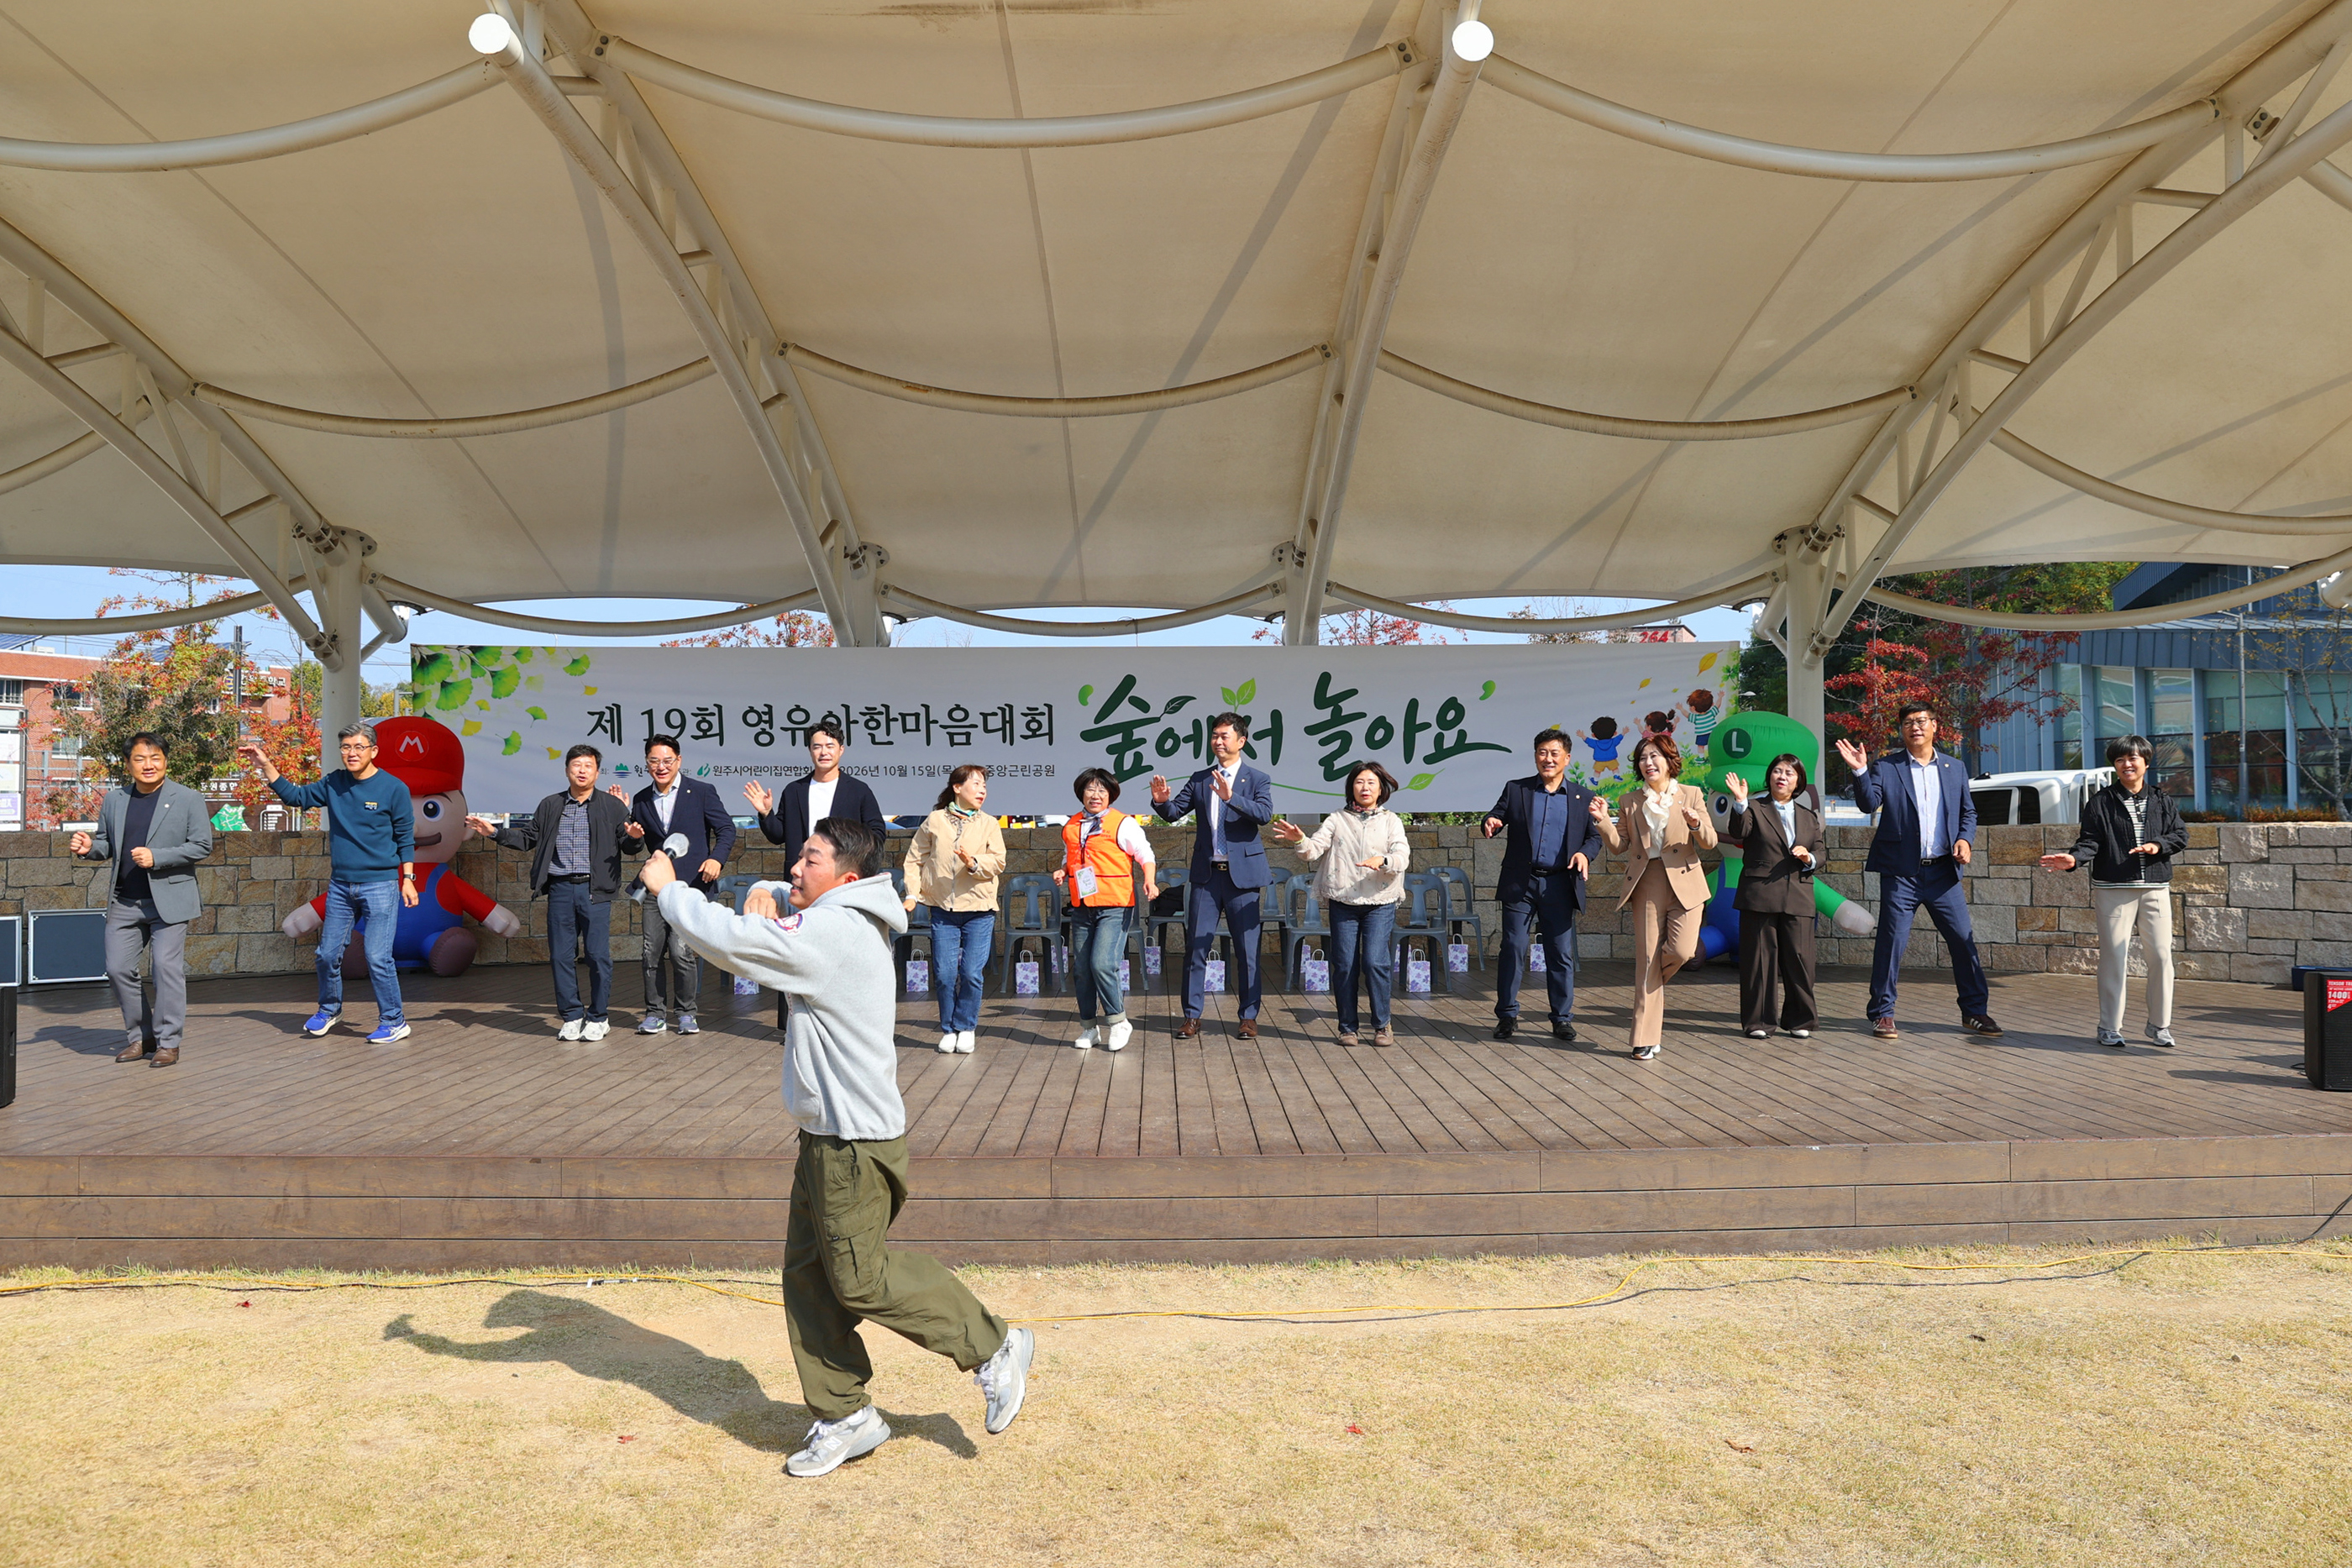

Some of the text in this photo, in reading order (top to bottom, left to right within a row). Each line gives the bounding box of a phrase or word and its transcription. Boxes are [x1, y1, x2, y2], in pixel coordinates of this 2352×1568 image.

[1639, 631, 1669, 643] 264
[587, 703, 1053, 747] 제 19회 영유아한마음대회
[399, 735, 424, 754] M
[1731, 731, 1745, 753] L
[713, 765, 812, 777] 원주시어린이집연합회
[883, 765, 908, 777] 10월
[985, 764, 1055, 777] 중앙근린공원
